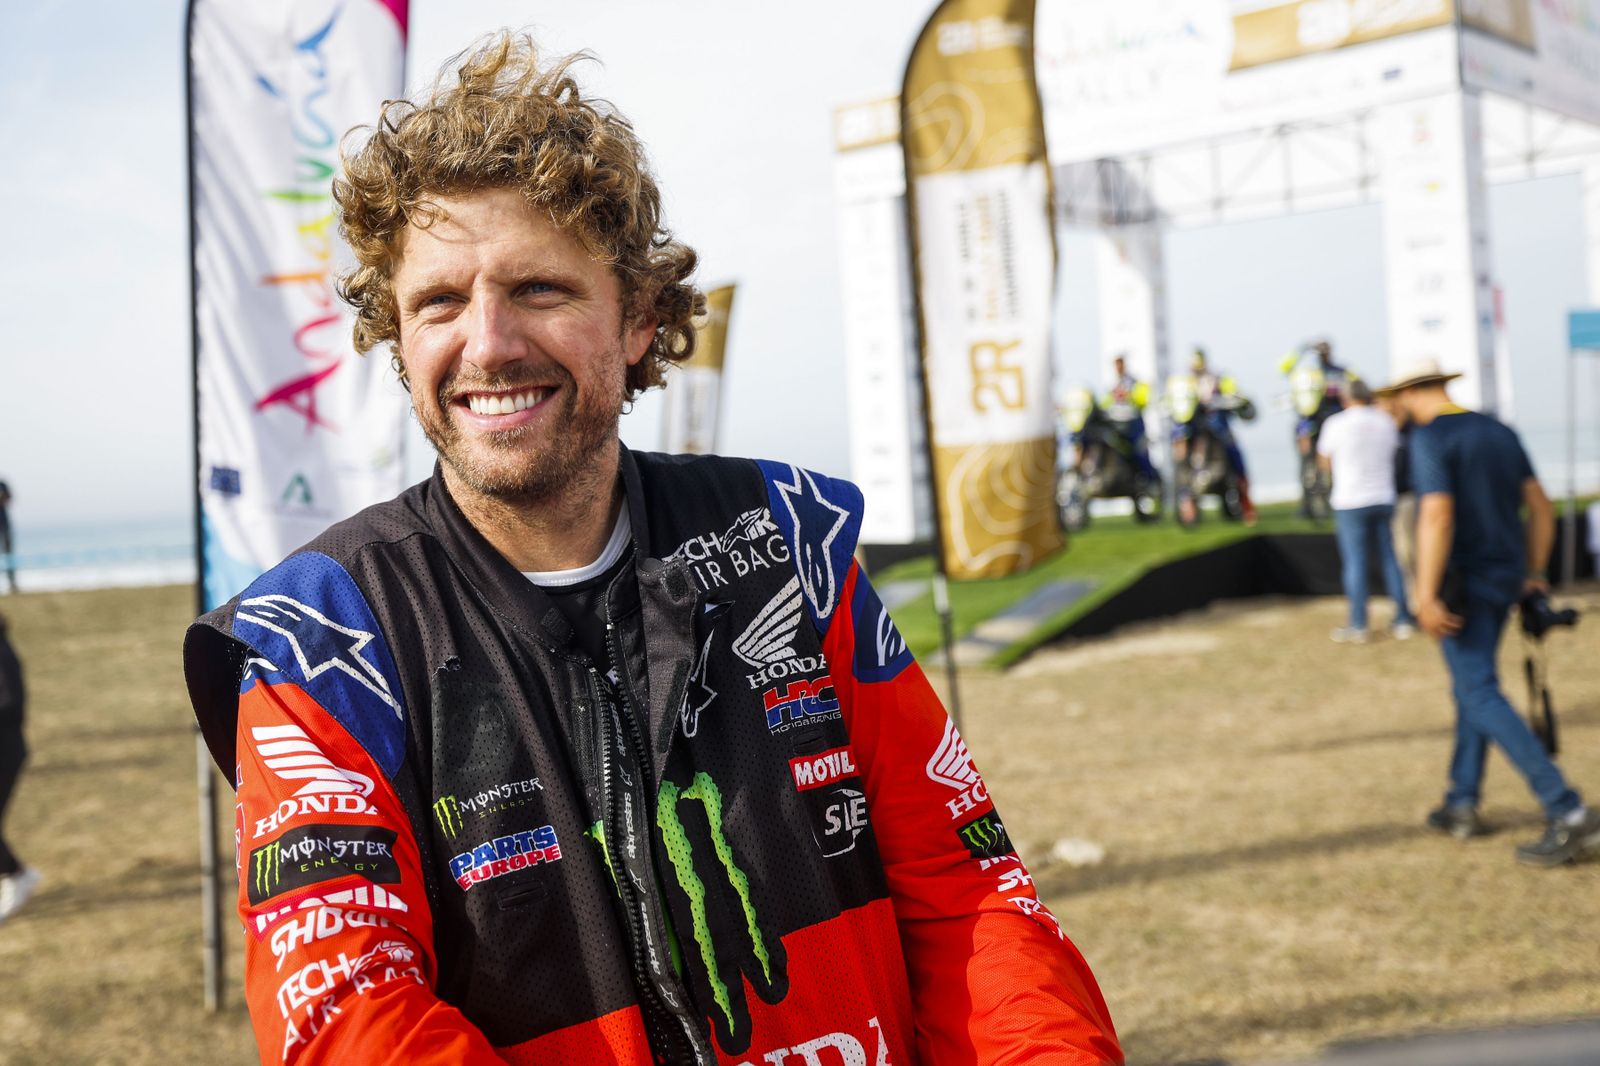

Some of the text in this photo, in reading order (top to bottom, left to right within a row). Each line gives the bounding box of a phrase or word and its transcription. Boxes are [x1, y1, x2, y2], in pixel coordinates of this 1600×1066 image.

[729, 534, 790, 577] BAG
[459, 777, 544, 813] MONSTER
[624, 792, 636, 859] alpinestars
[280, 836, 393, 864] MONSTER
[300, 856, 379, 873] ENEGY
[448, 824, 558, 880] PARTS
[456, 843, 562, 892] EUROPE
